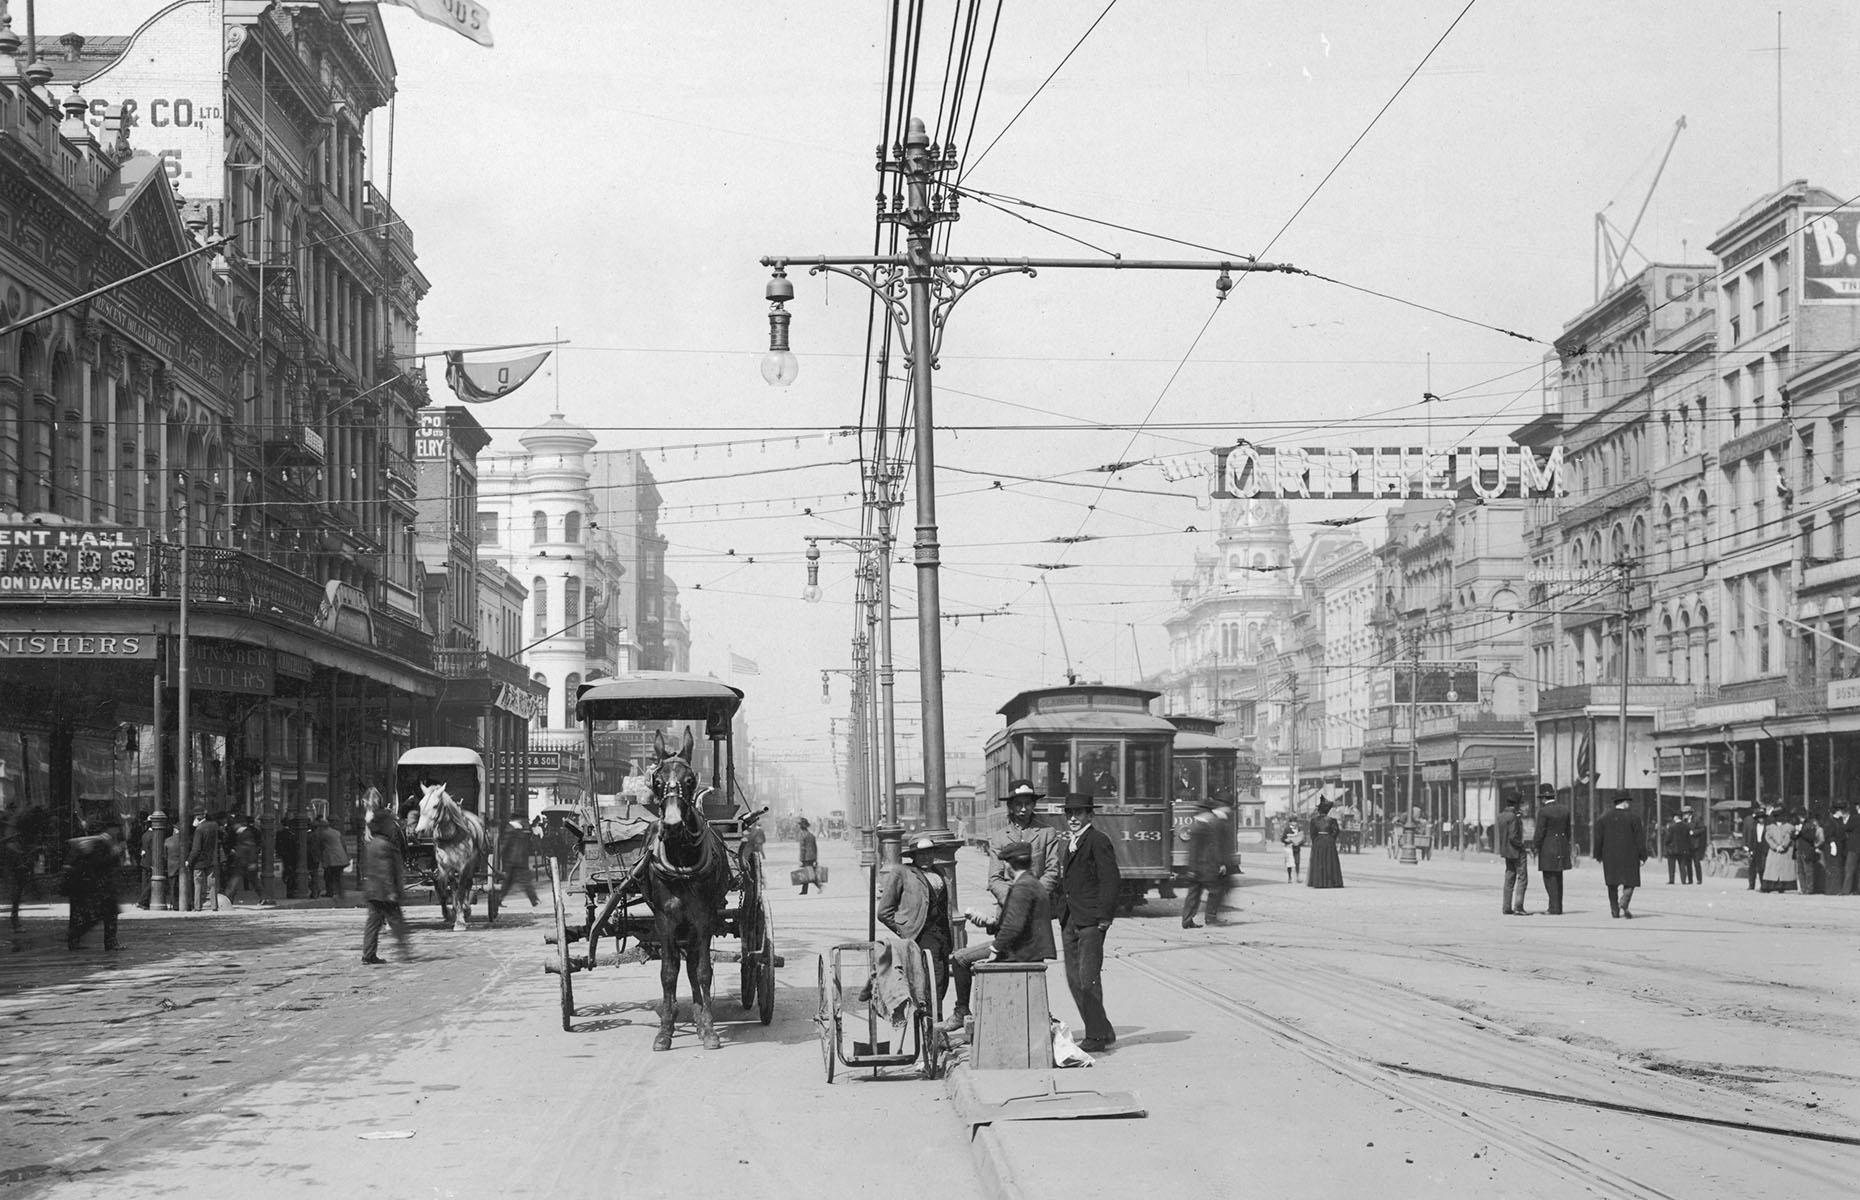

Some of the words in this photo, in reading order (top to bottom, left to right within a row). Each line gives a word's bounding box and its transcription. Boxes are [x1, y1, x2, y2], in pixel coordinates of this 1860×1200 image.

[415, 439, 446, 457] ELRY.
[1225, 445, 1565, 499] ORPHEUM
[191, 664, 267, 691] ATTERS
[1120, 830, 1162, 841] 143
